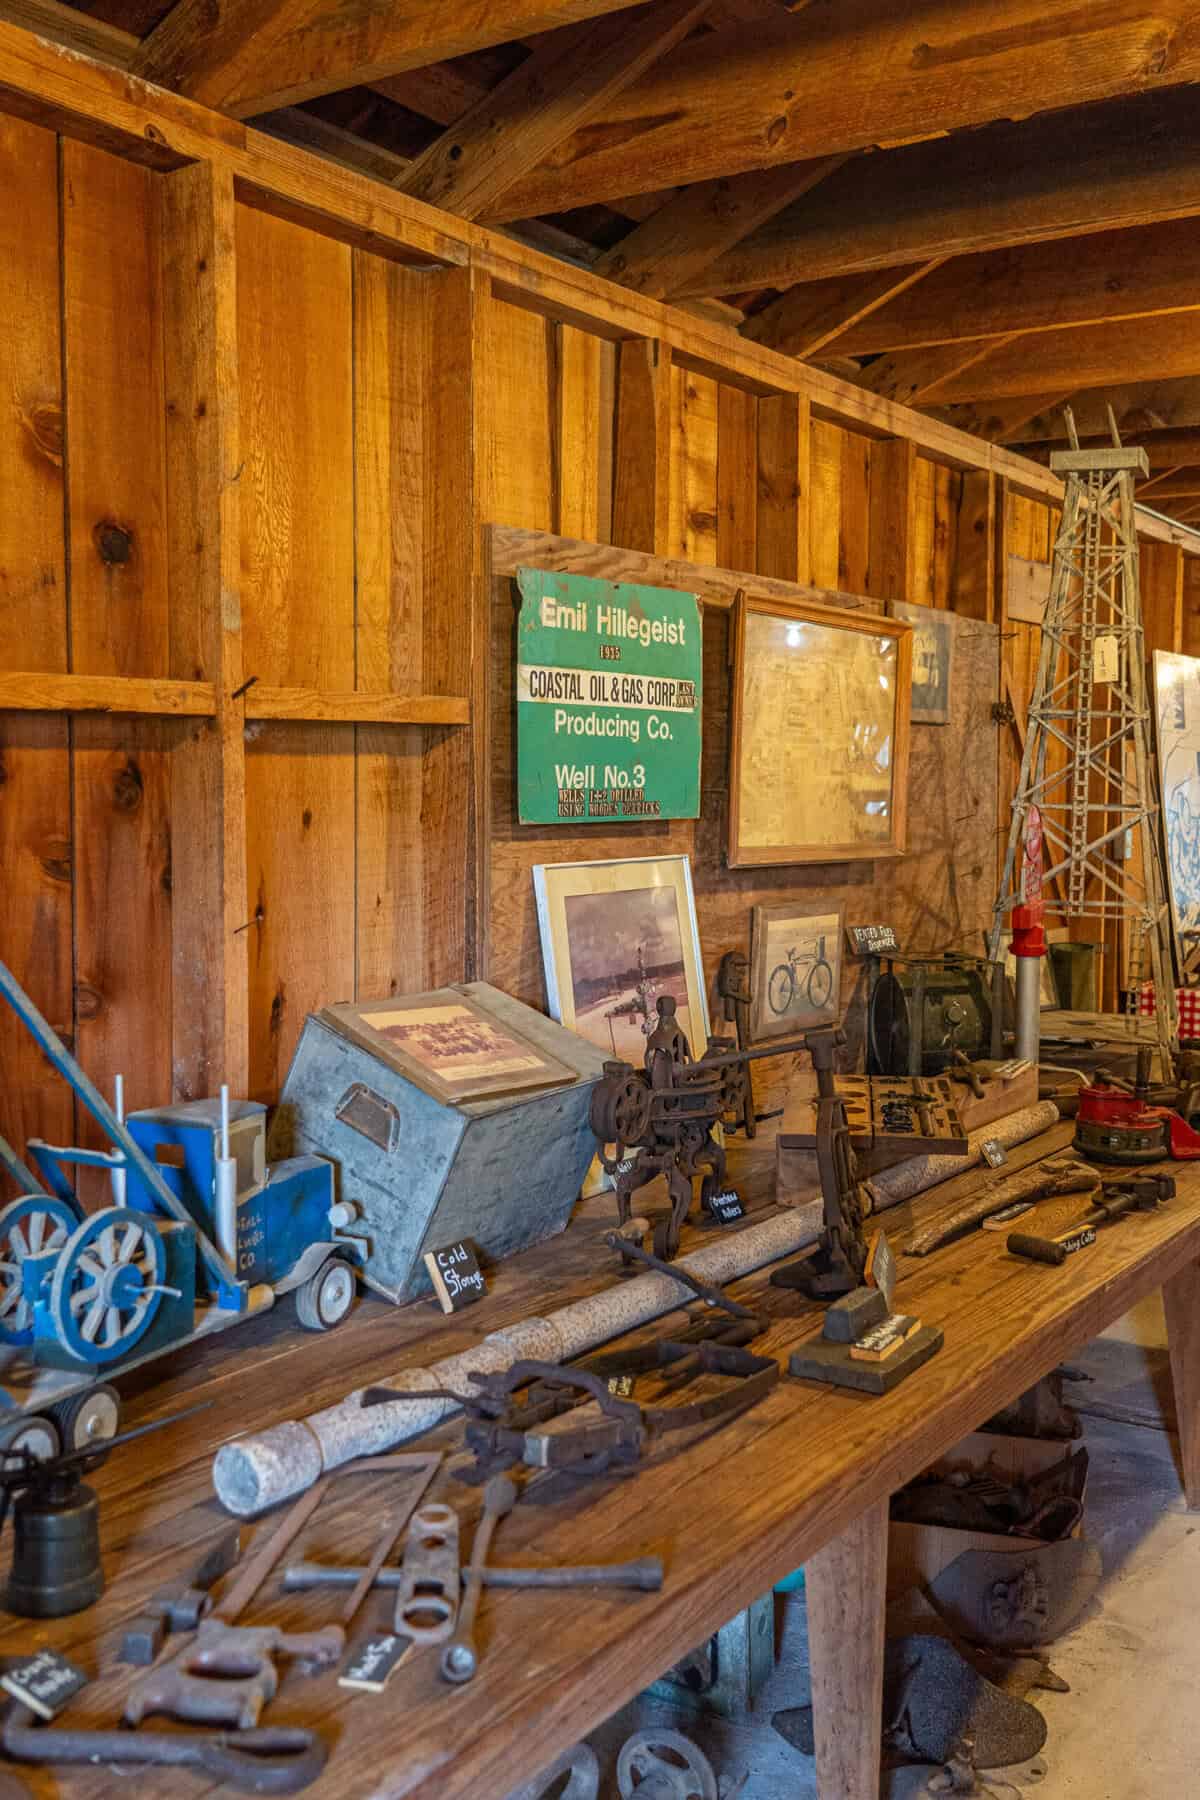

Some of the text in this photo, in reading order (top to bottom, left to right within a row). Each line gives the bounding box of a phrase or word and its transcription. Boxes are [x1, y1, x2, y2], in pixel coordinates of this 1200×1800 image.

[541, 596, 686, 647] Emil Hillegeist
[530, 670, 584, 701] COASTAL
[590, 675, 609, 702] OIL
[621, 677, 644, 704] GAS
[647, 680, 676, 707] CORP.
[555, 709, 673, 743] Producing Co.
[555, 764, 646, 788] Well No.3
[559, 789, 585, 802] WELLS
[558, 802, 584, 816] USING
[437, 1243, 469, 1267] Cold
